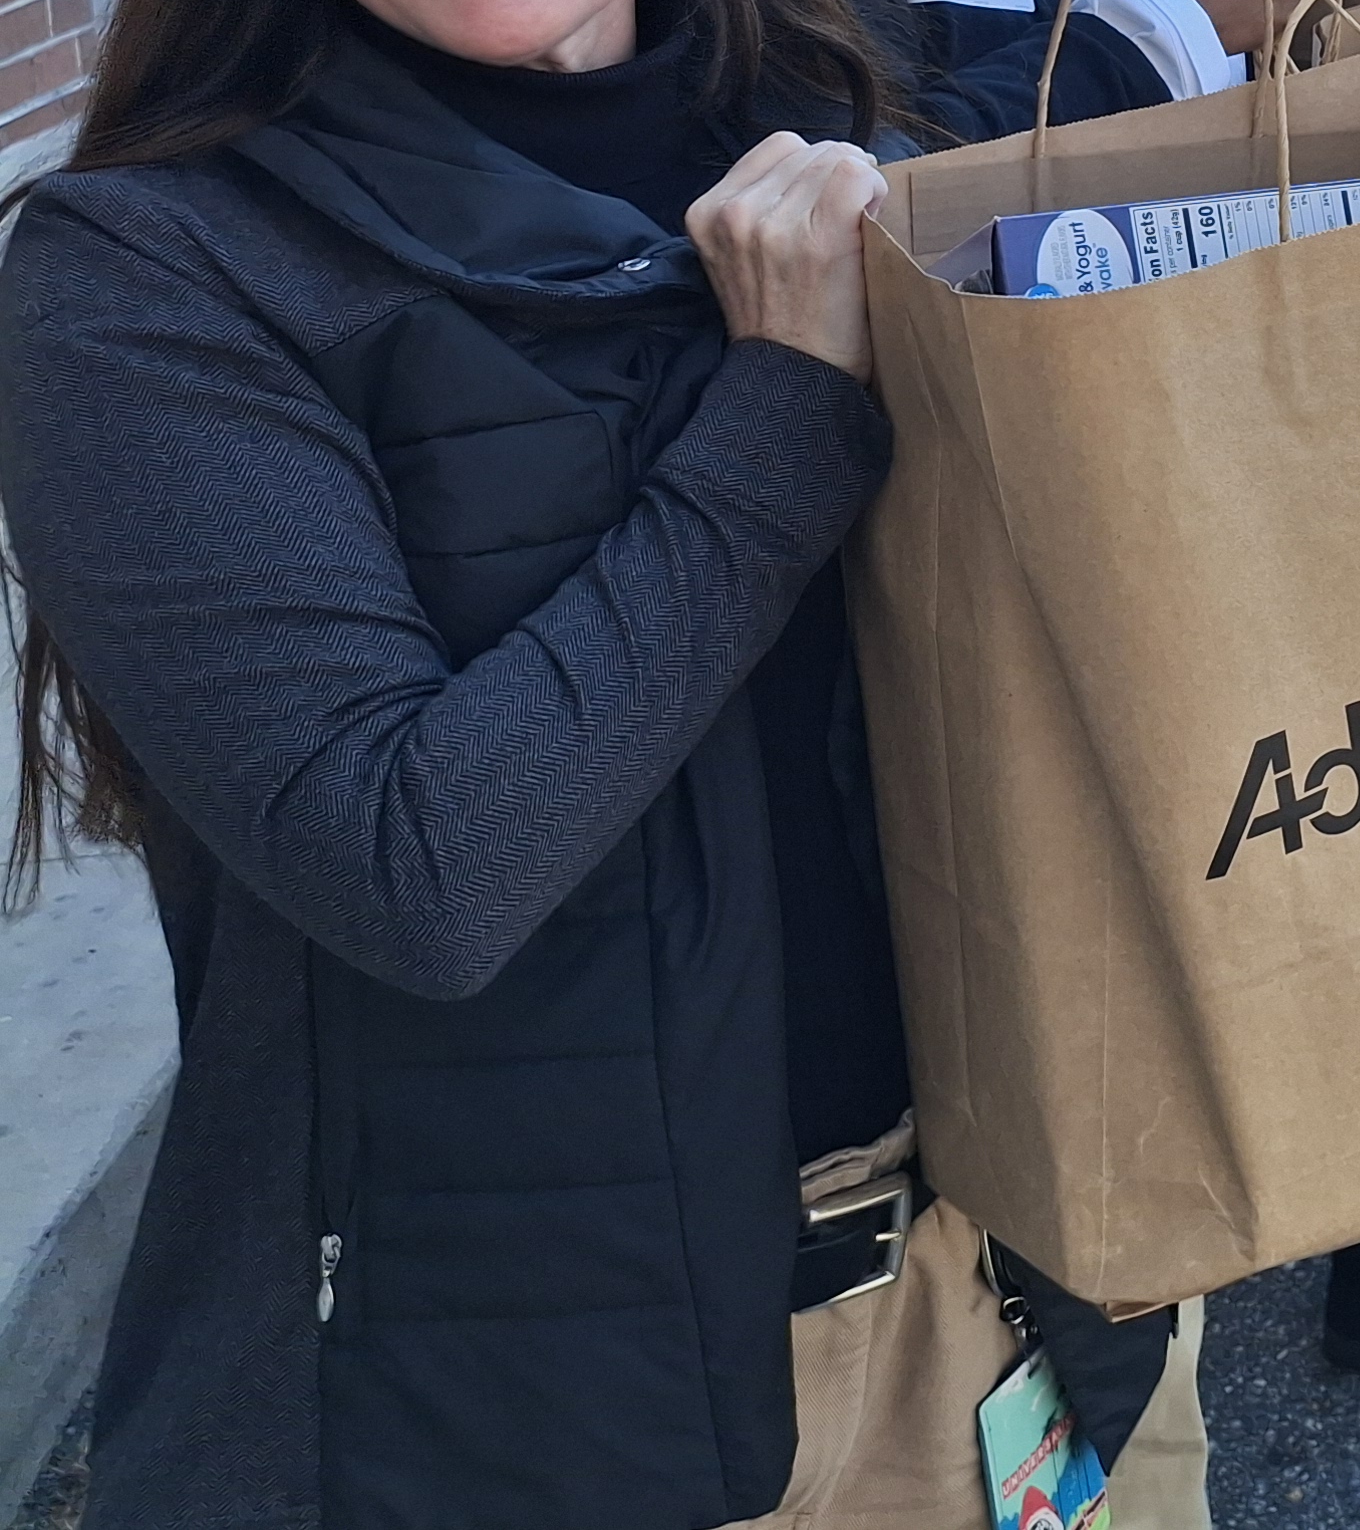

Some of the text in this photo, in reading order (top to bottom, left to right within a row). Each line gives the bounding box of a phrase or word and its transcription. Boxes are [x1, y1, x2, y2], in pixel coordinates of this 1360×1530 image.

[1140, 211, 1159, 255] Facts
[1198, 206, 1218, 238] 160
[1068, 221, 1094, 293] & Yogurt
